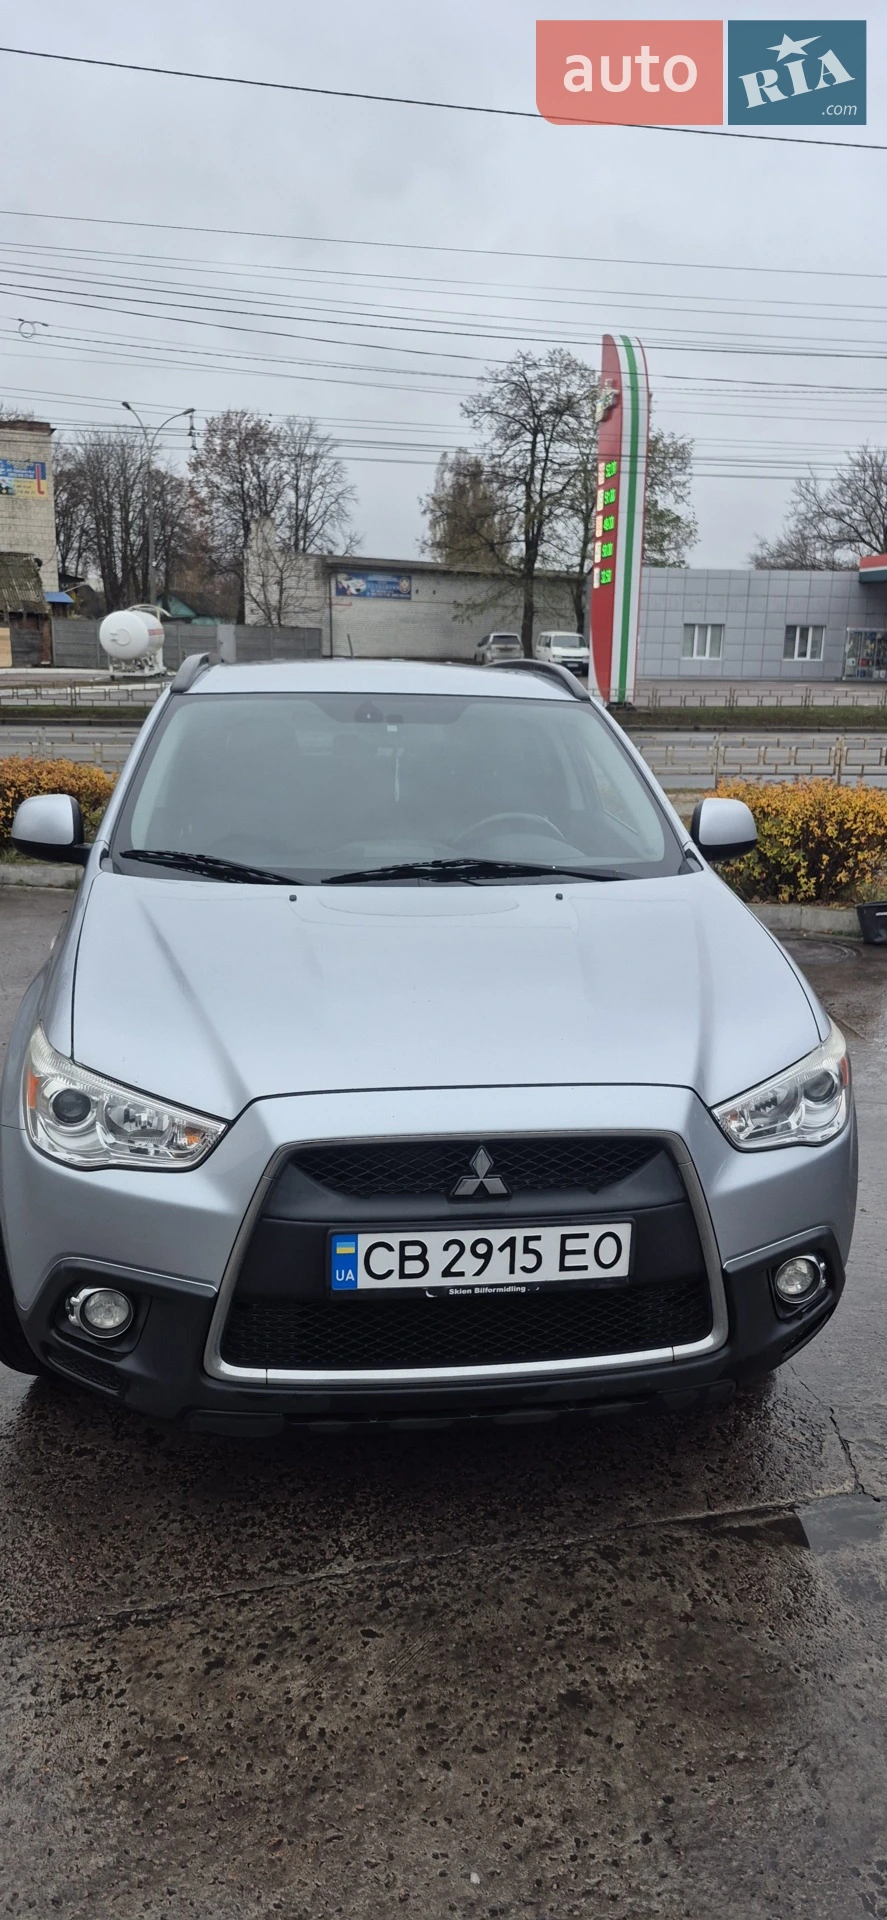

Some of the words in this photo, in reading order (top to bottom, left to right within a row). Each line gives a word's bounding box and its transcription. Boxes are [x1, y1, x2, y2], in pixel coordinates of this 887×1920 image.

[363, 1240, 430, 1281] CB
[441, 1235, 543, 1279] 2915
[558, 1230, 623, 1273] EO
[335, 1269, 355, 1282] UA
[448, 1288, 472, 1296] Skien
[474, 1285, 526, 1294] Bilformidling
